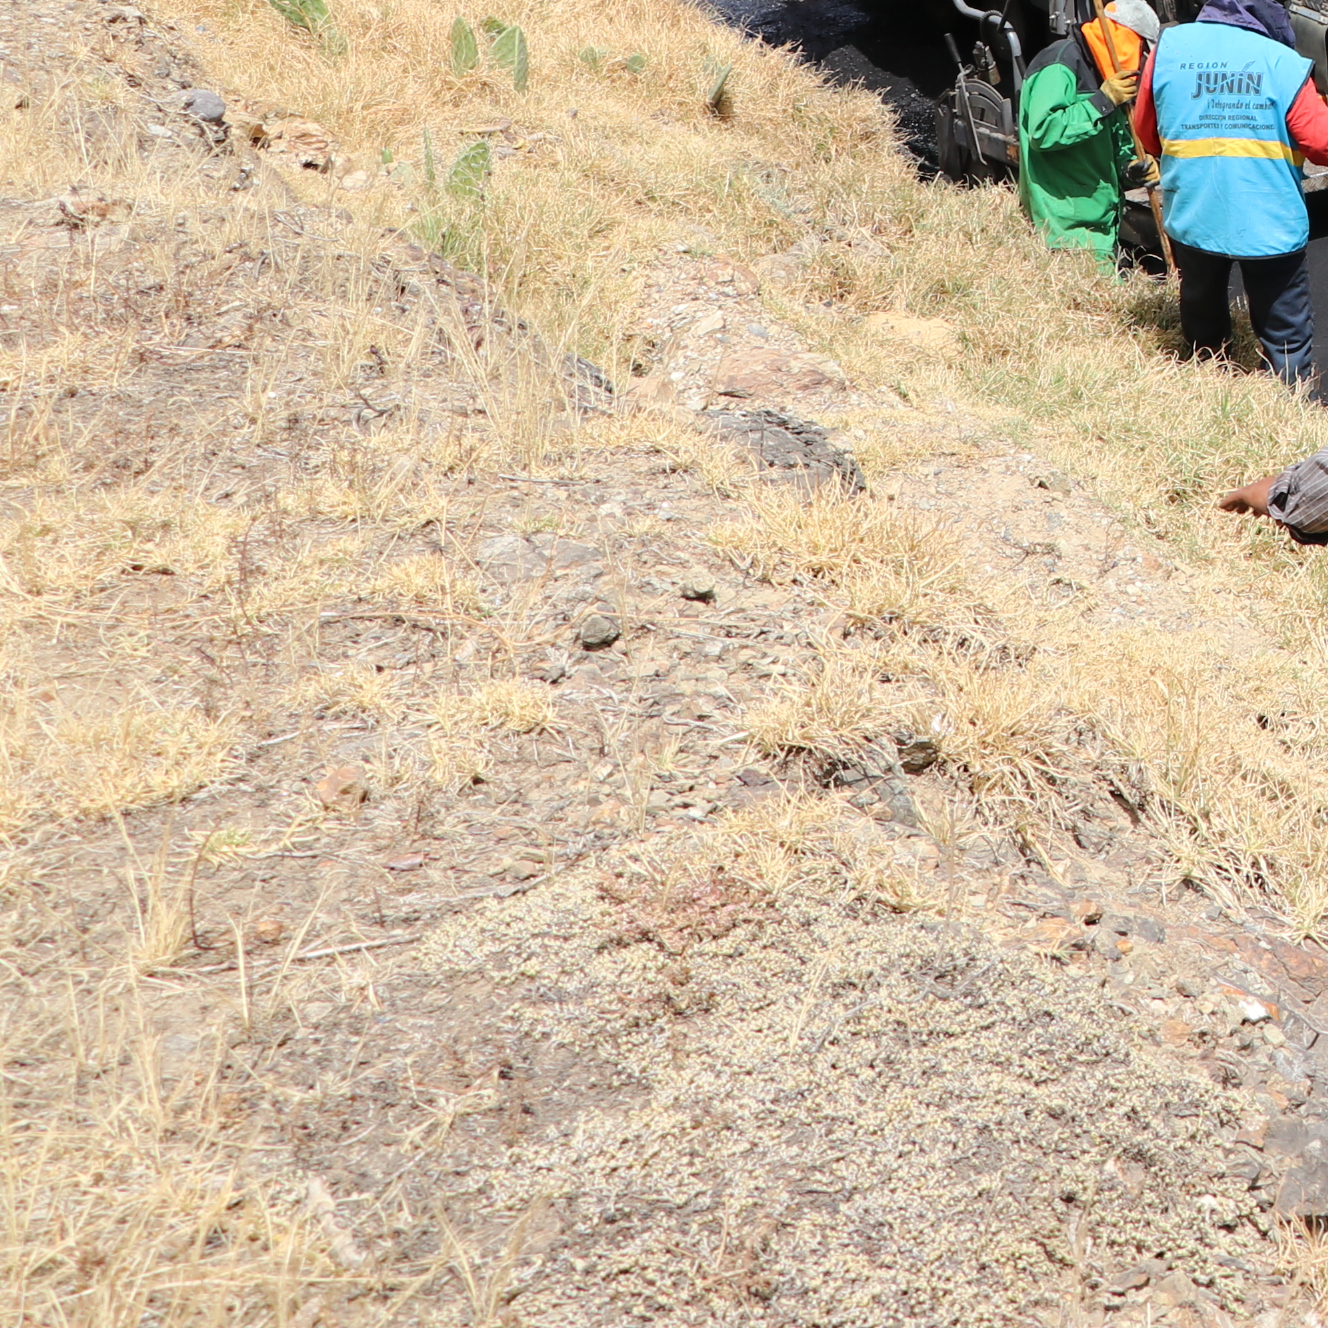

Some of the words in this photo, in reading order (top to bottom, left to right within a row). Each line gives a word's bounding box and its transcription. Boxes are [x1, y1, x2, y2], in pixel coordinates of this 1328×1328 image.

[1180, 60, 1229, 70] REGION
[1191, 60, 1264, 100] JUNÍN
[1245, 100, 1251, 110] el
[1228, 114, 1257, 122] REGIONAL
